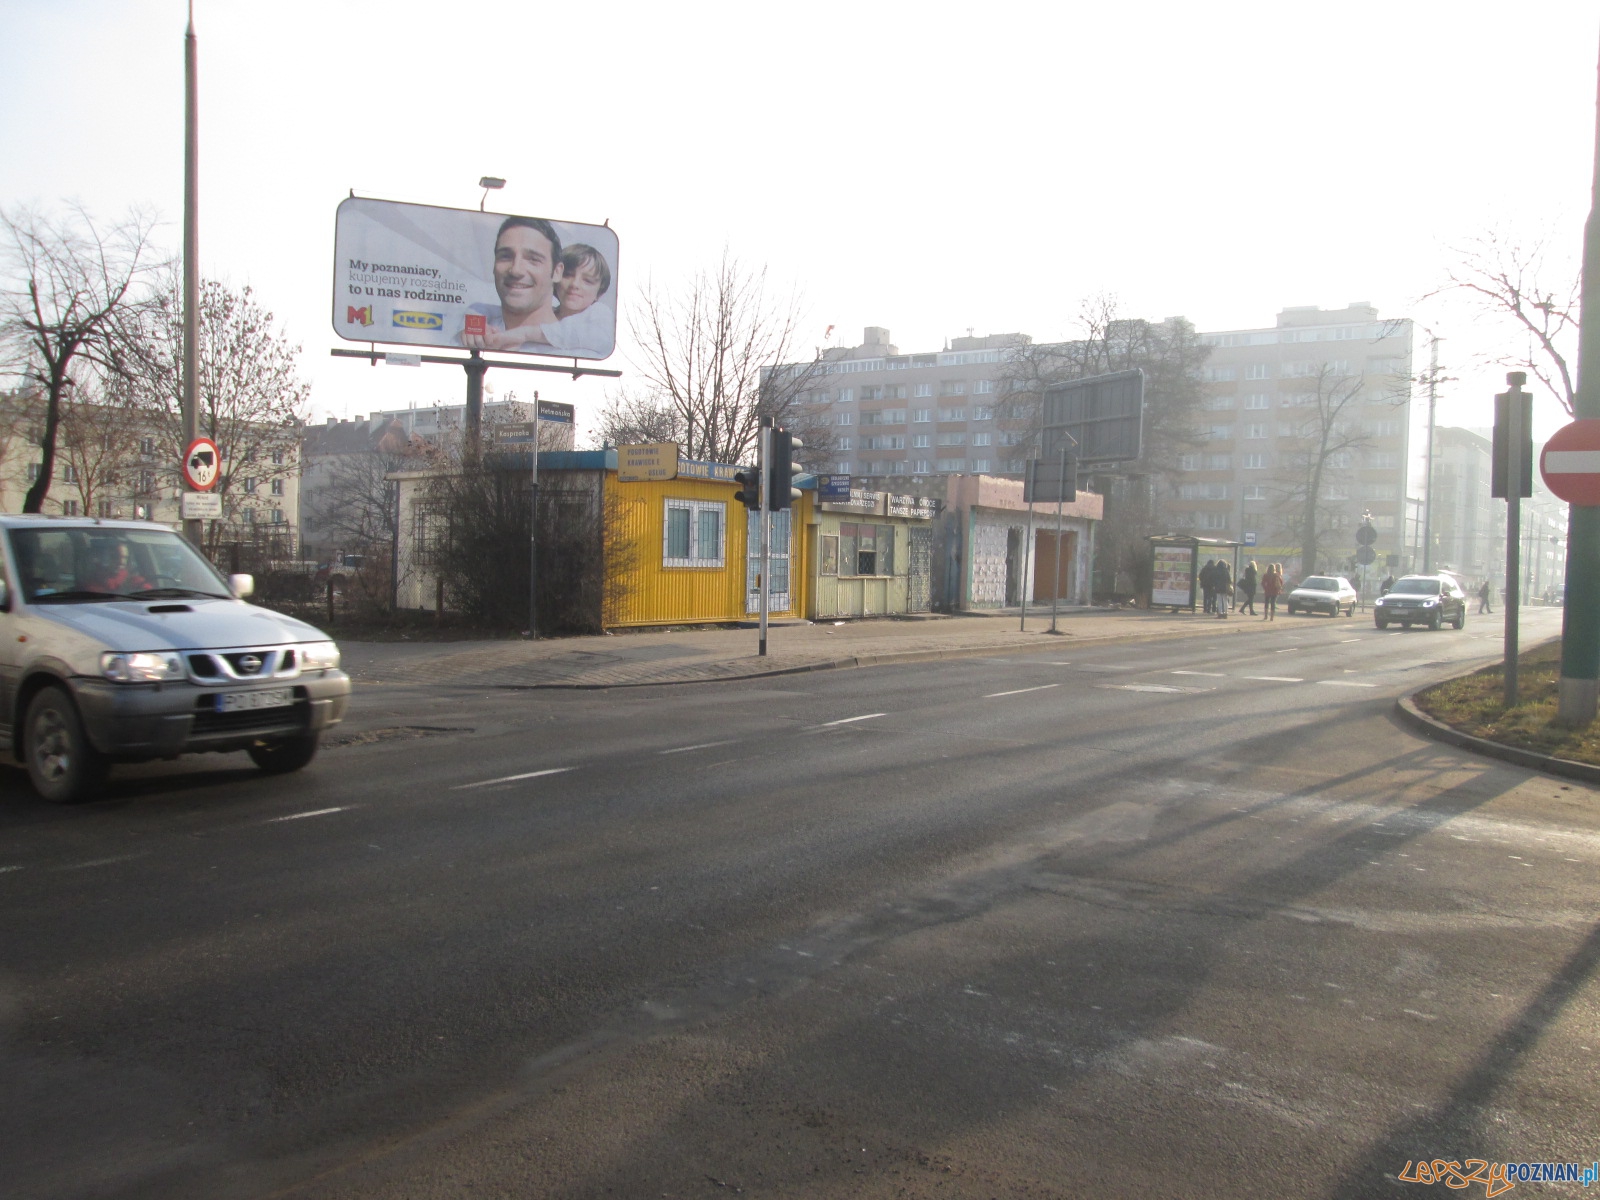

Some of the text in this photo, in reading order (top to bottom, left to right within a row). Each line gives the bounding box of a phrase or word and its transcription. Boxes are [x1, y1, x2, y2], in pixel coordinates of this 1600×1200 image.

[349, 259, 442, 279] My poznaniacy,
[349, 270, 468, 292] kupujemy rozsądnie,
[348, 284, 466, 304] to u nas rodzinne.
[347, 304, 438, 327] M1 IKEA
[198, 471, 206, 482] 16
[918, 498, 936, 507] OWOCE
